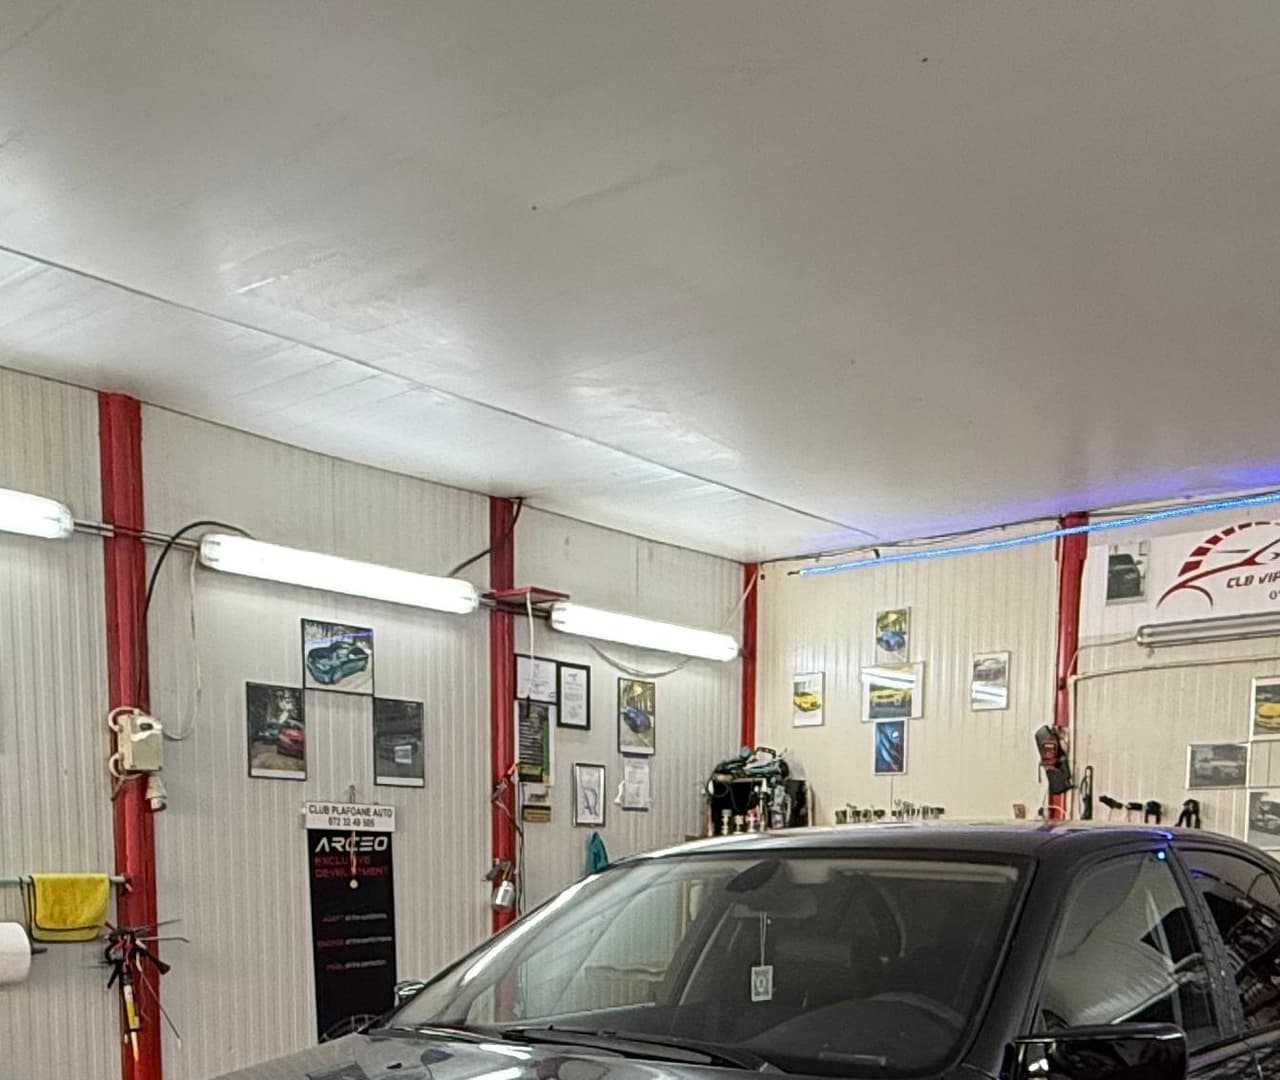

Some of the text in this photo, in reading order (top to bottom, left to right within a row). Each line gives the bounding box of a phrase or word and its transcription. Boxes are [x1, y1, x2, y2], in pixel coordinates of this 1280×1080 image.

[1226, 575, 1254, 589] CLB
[309, 805, 393, 818] CLUB PLAFOANE AUTO
[315, 836, 388, 853] ARCEO
